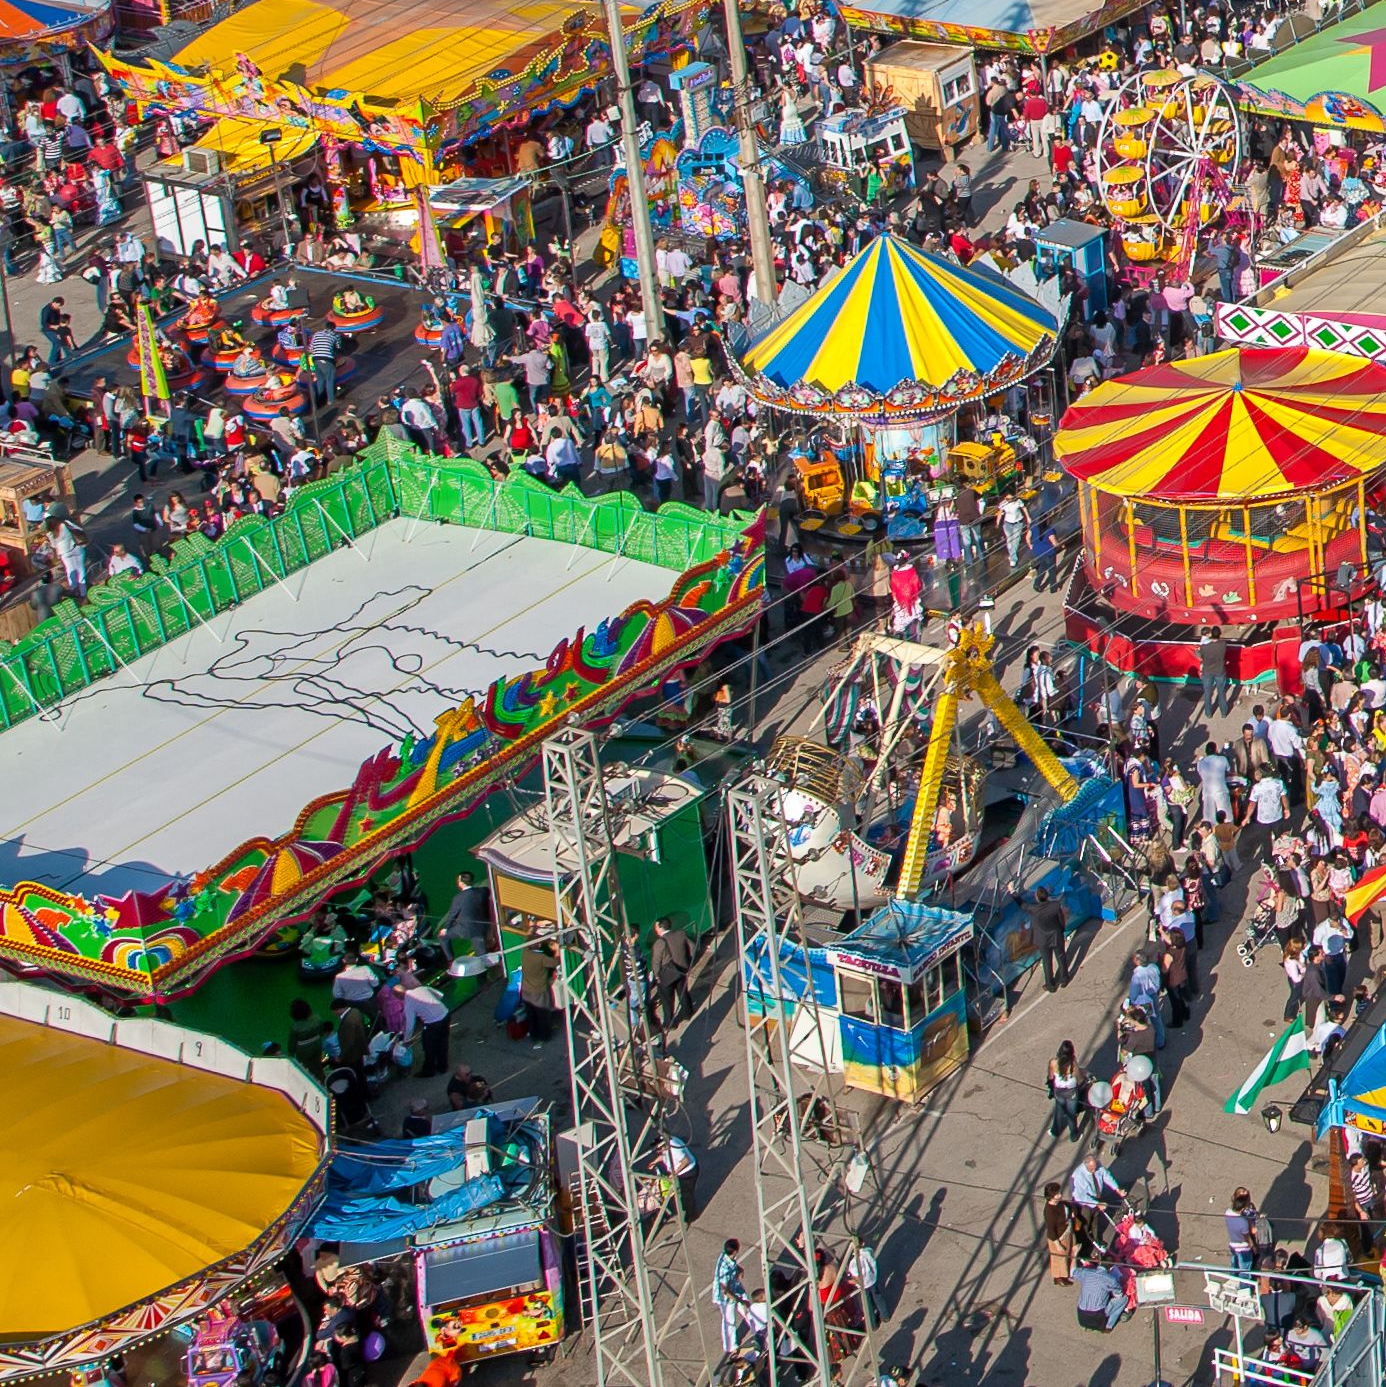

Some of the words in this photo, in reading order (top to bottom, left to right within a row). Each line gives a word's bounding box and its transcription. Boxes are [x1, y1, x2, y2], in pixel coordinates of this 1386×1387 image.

[837, 953, 899, 977] TAQUILLA
[57, 1005, 72, 1021] 10
[195, 1041, 204, 1058] 9
[1168, 1308, 1202, 1321] SALIDA
